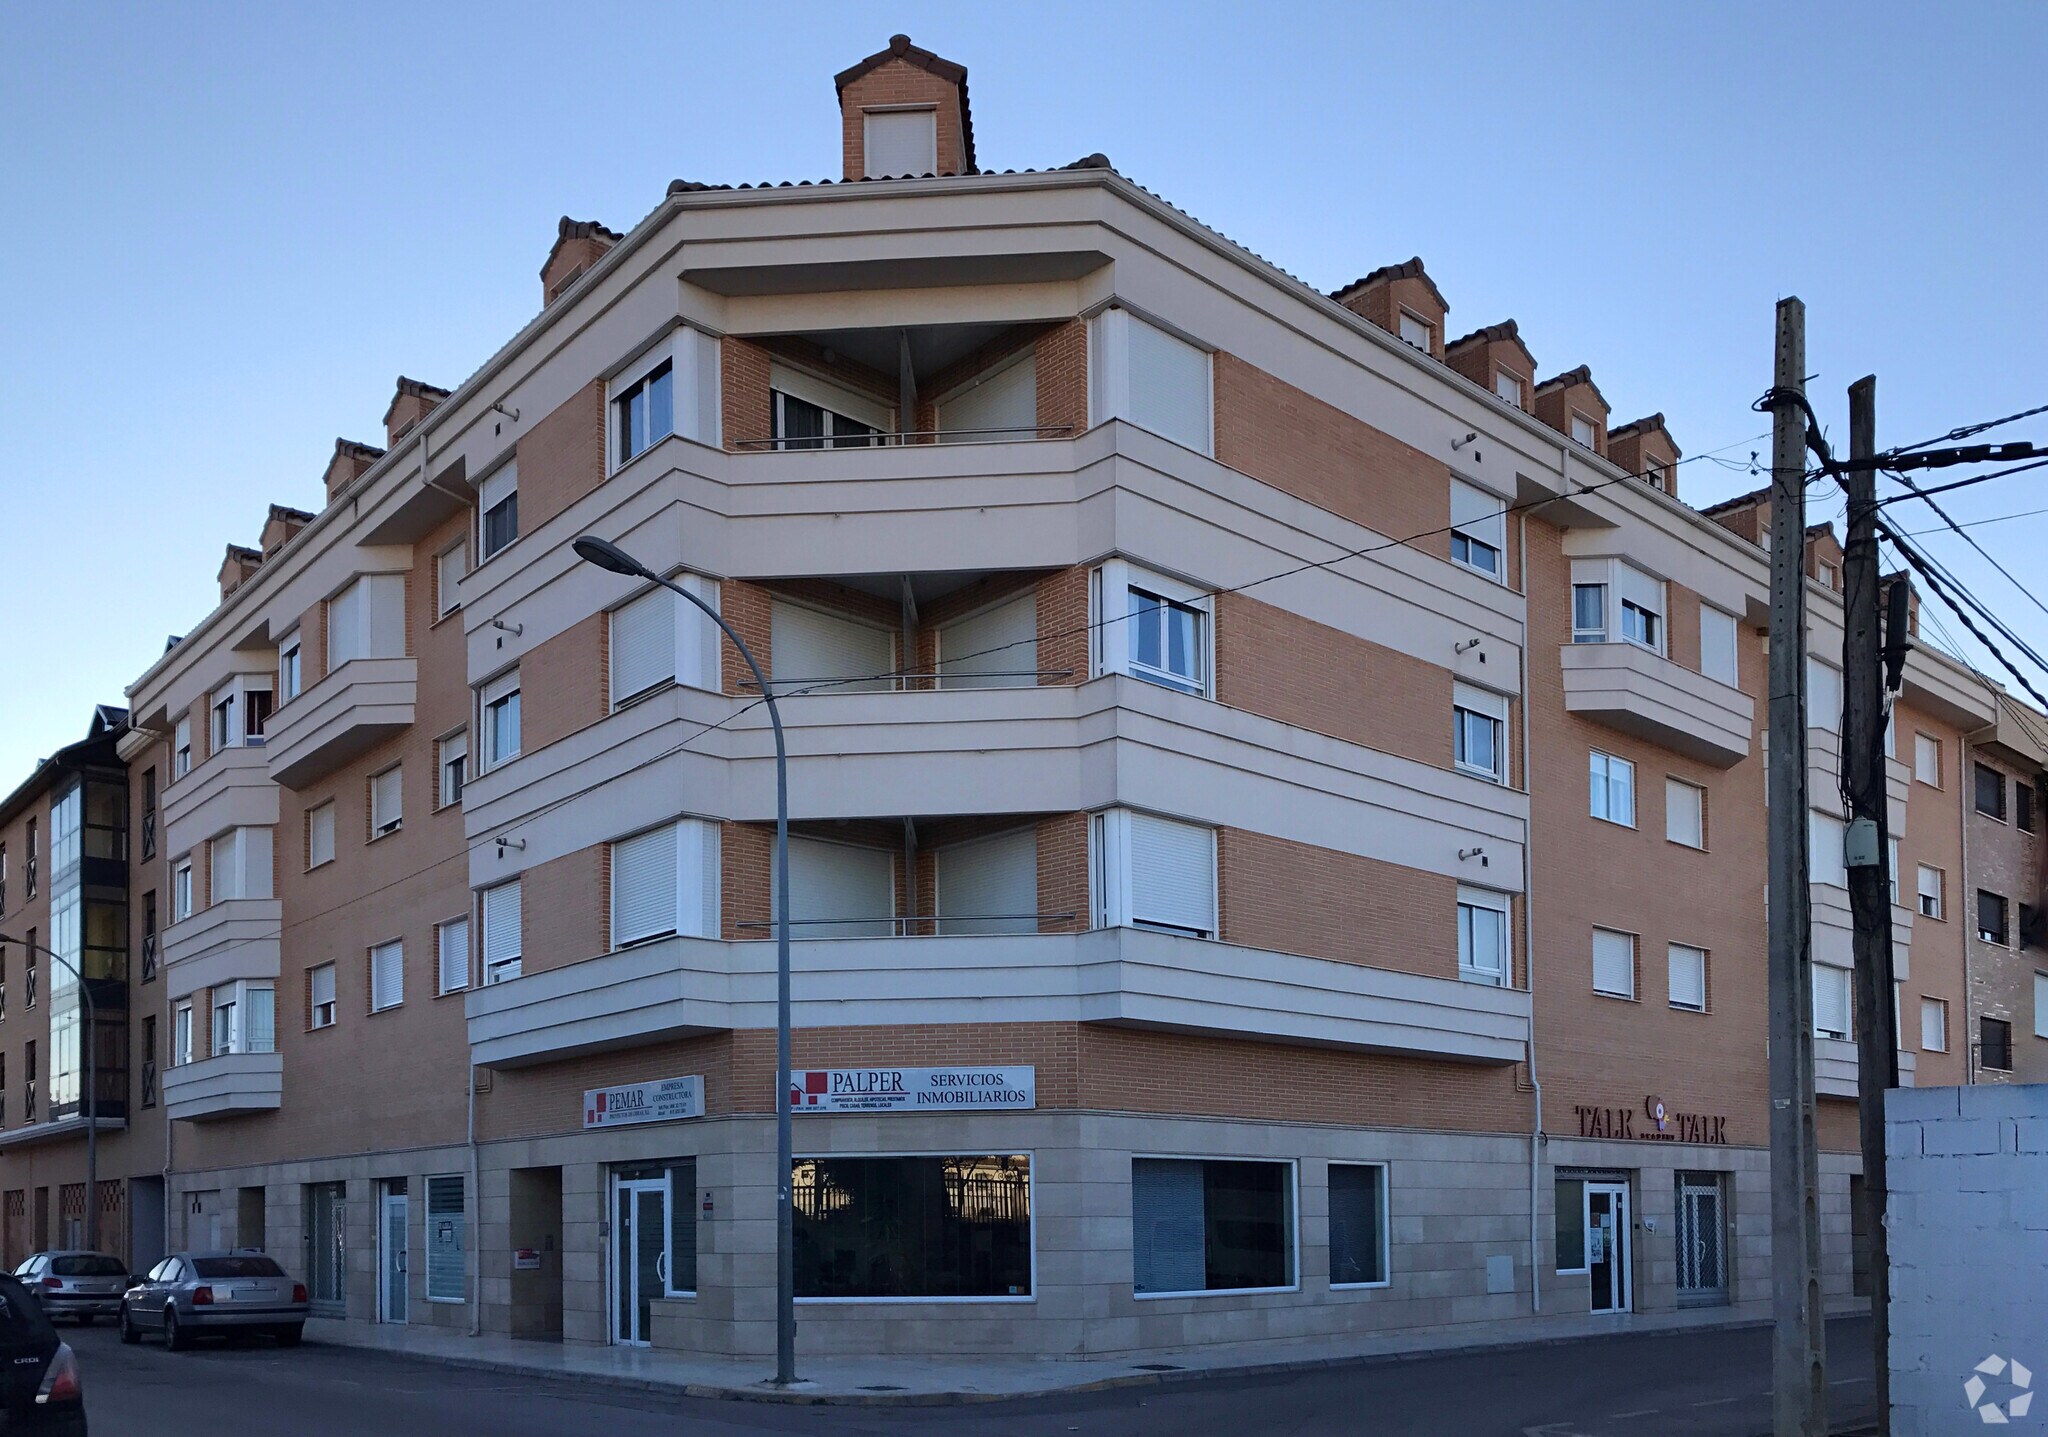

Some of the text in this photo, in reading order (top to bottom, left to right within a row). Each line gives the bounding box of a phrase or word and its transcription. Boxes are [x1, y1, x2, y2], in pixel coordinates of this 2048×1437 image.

[660, 1082, 684, 1092] EMPRESA
[833, 1071, 904, 1093] PALPER
[930, 1073, 1004, 1087] SERVICIOS
[609, 1089, 644, 1111] PEMAR
[652, 1090, 693, 1103] CONSTRUCTORA
[917, 1090, 1026, 1104] INMOBILIARIOS
[1575, 1105, 1727, 1144] TALK TALK
